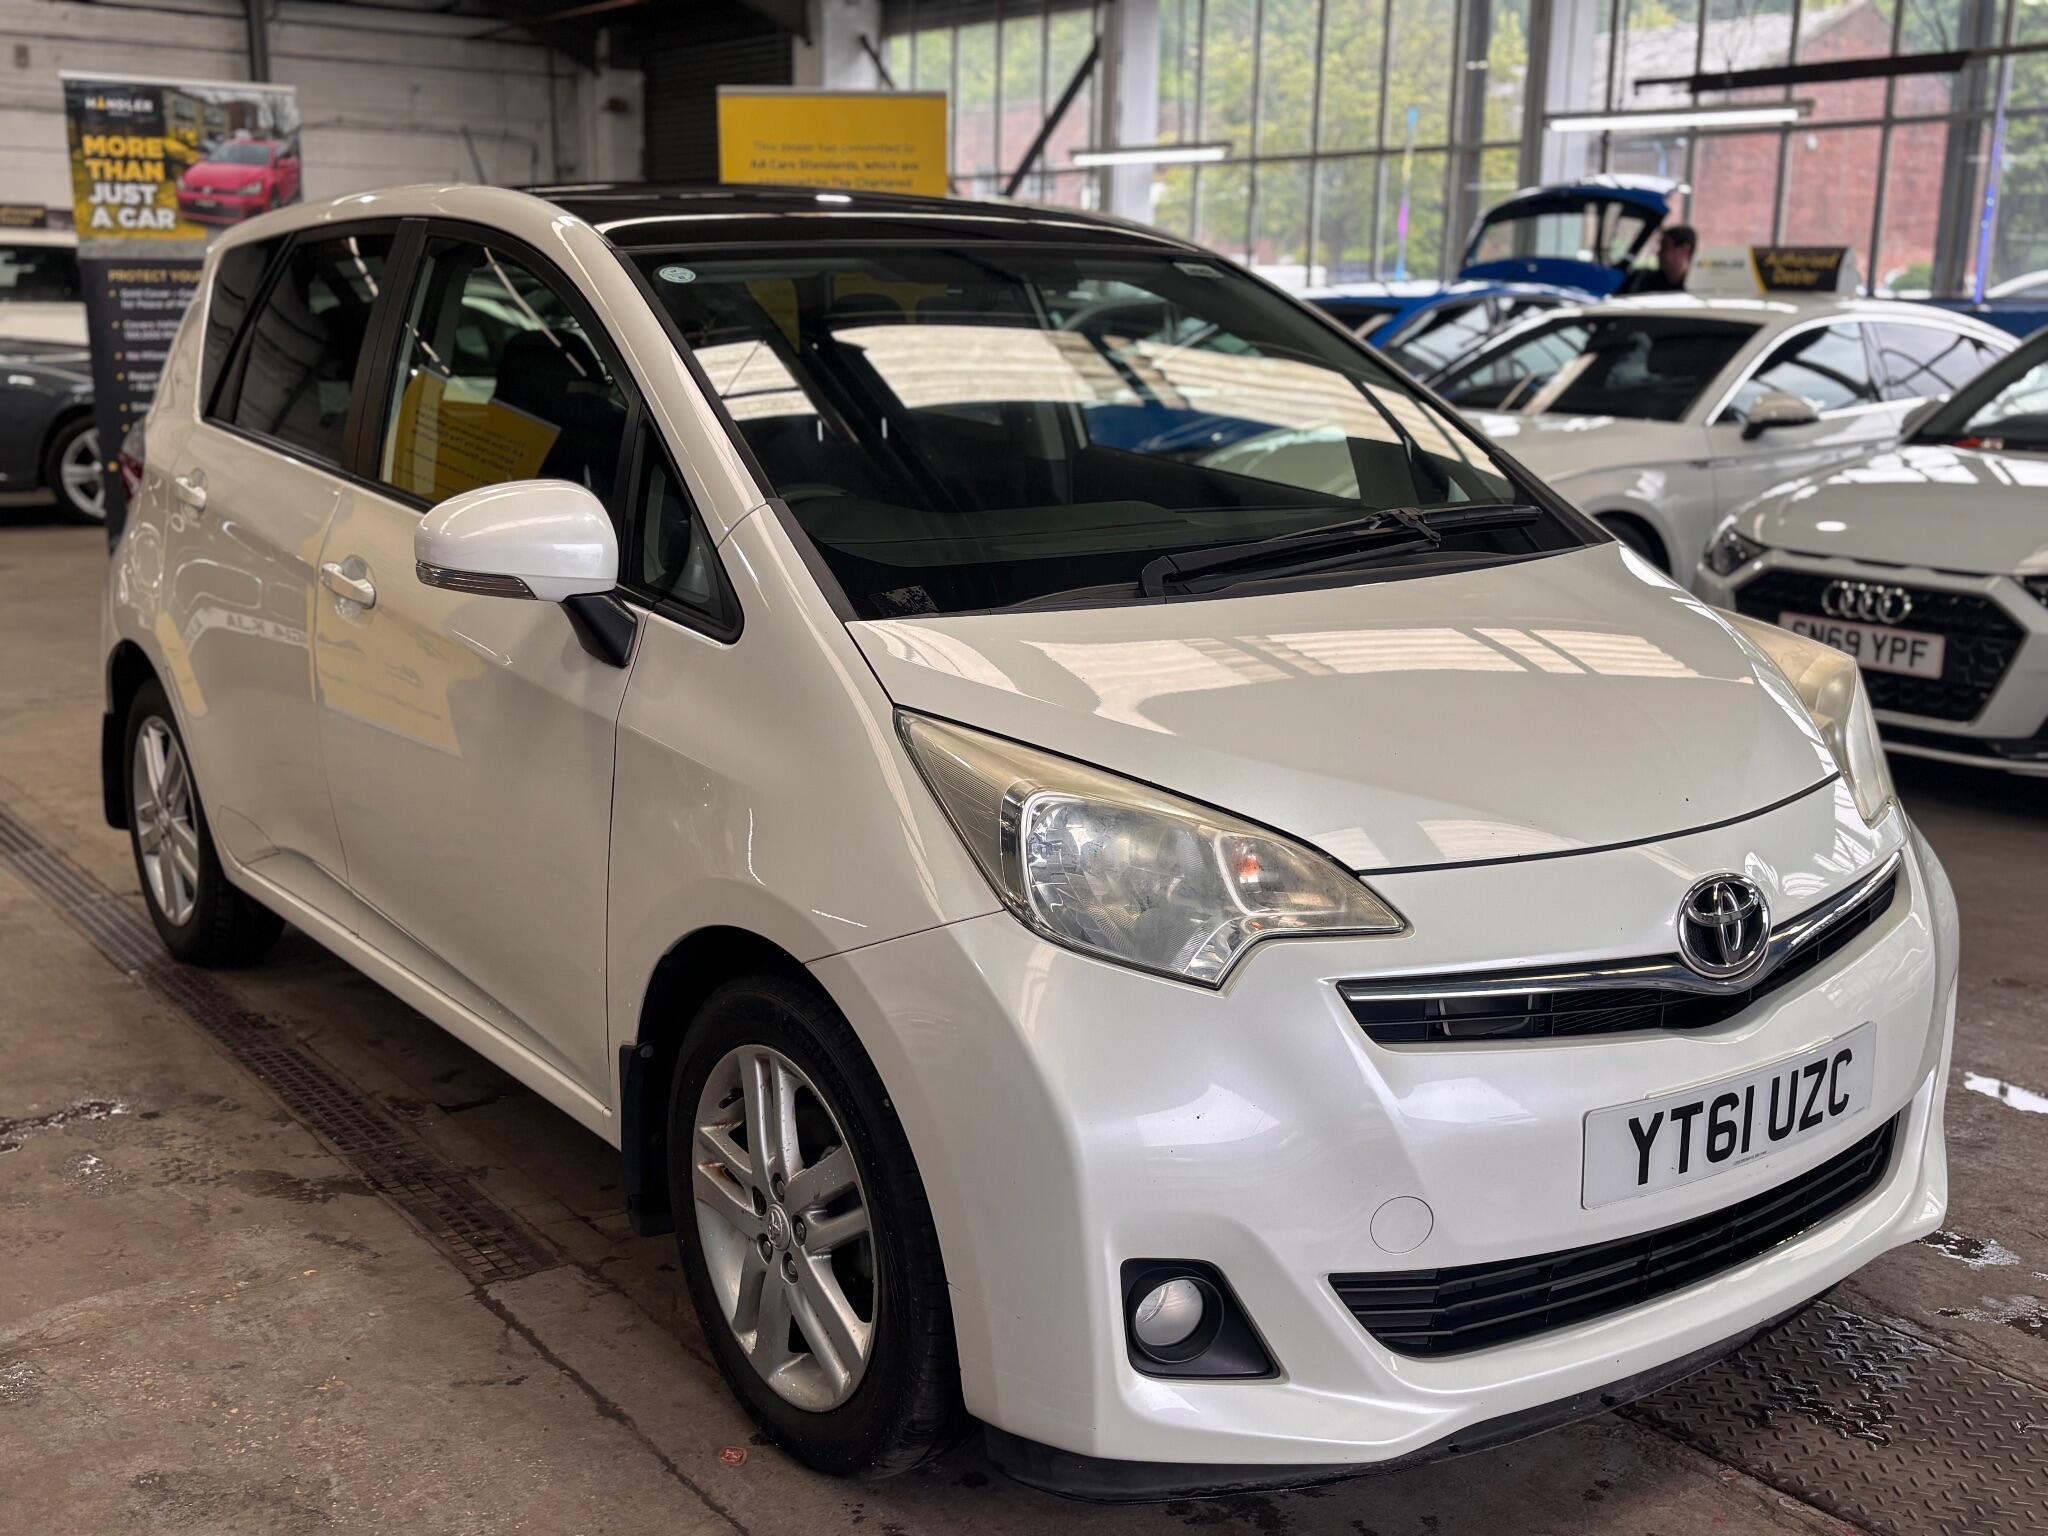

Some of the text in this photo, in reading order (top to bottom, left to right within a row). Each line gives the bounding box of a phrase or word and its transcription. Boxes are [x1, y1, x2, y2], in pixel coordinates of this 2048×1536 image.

[82, 134, 164, 158] MORE
[84, 158, 165, 182] THAN
[88, 182, 158, 206] JUST
[90, 206, 176, 229] A CAR
[107, 269, 167, 282] PROTECT
[1871, 631, 1930, 668] YPF
[1628, 1048, 1853, 1186] YT61 UZC
